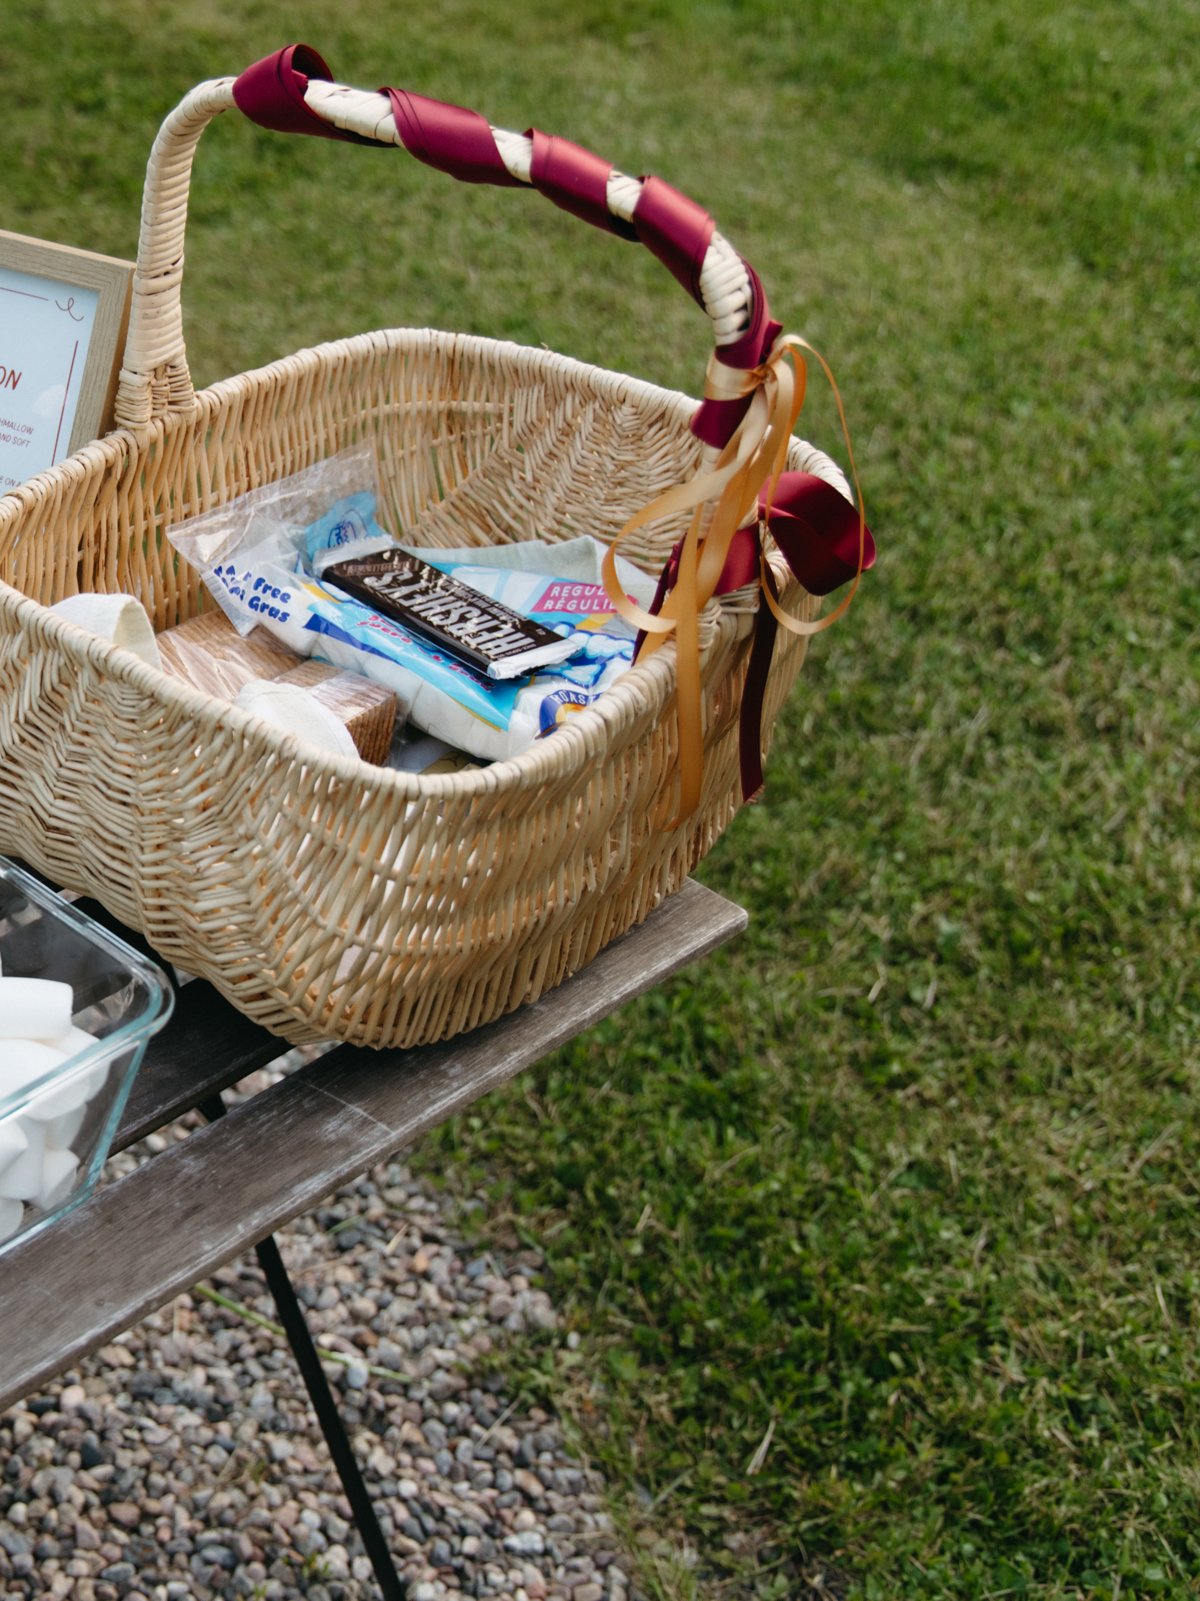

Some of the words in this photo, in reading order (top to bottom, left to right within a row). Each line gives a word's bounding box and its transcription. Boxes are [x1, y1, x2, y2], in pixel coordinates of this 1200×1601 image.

[13, 436, 31, 448] SOFT
[4, 477, 15, 487] ON
[253, 577, 291, 604] Free
[550, 585, 606, 597] REGUL
[248, 596, 290, 623] Gras
